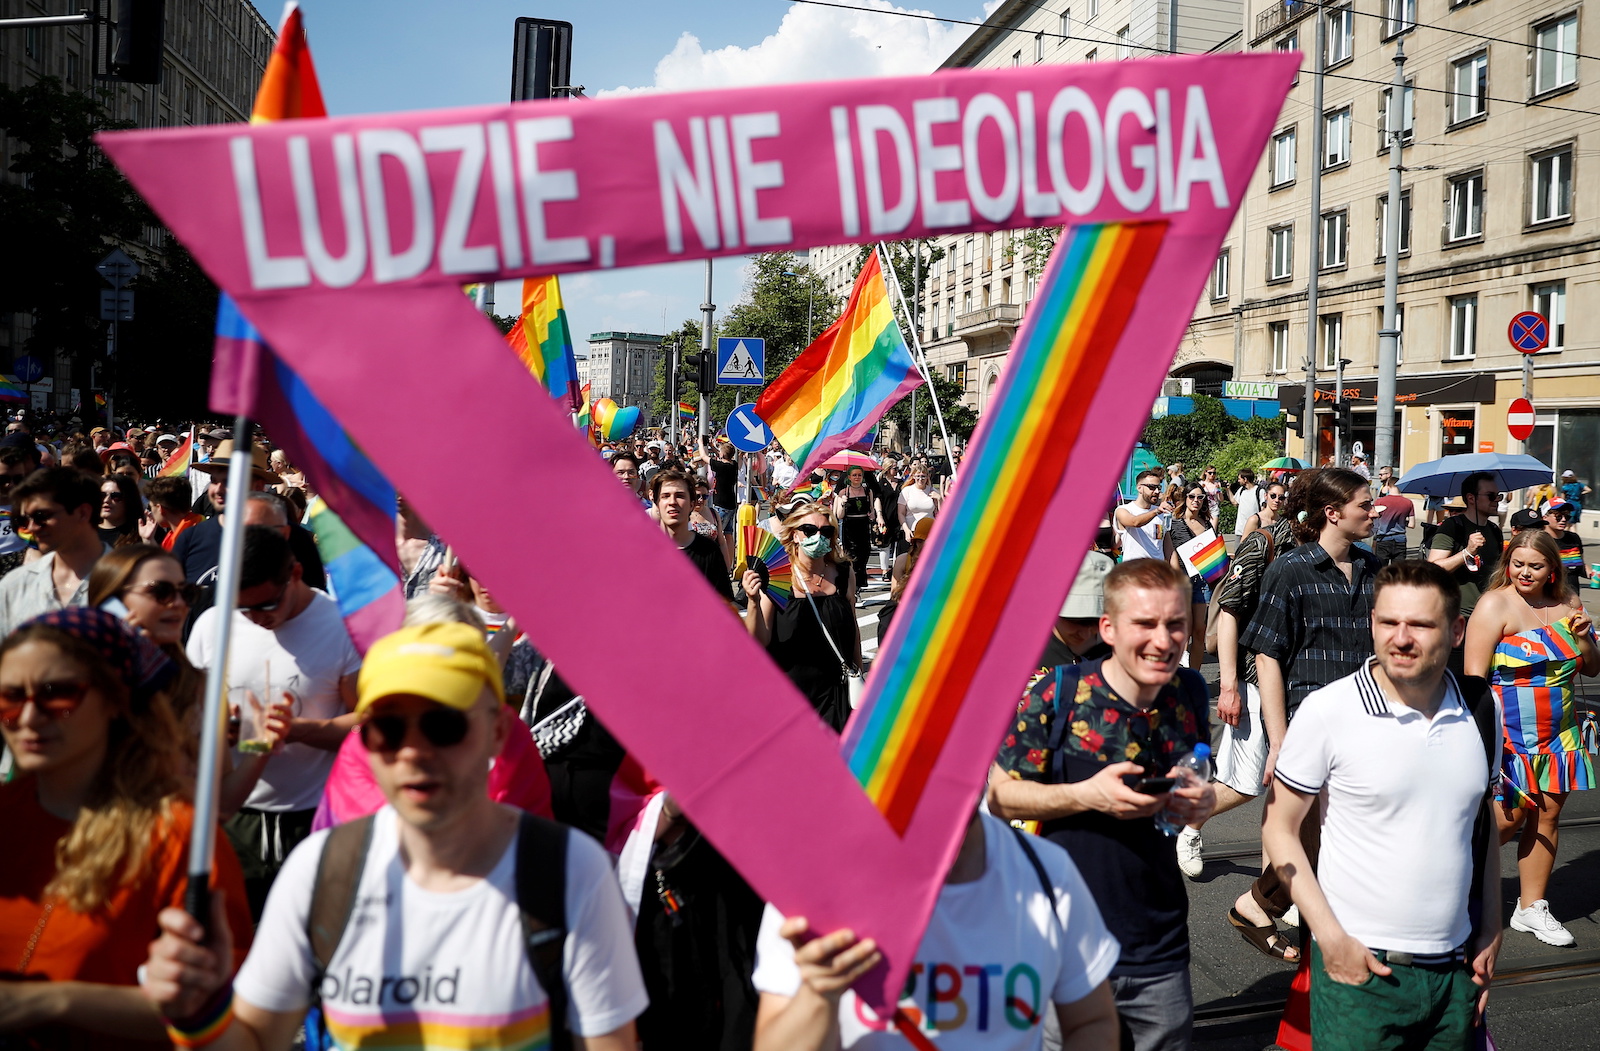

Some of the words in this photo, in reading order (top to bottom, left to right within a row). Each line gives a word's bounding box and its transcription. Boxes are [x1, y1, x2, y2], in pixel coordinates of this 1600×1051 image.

[229, 115, 616, 290] LUDZIE,
[653, 111, 793, 254] NIE
[830, 84, 1230, 237] IDEOLOGIA
[1226, 382, 1277, 397] KWIATY
[1443, 417, 1474, 429] Witamy
